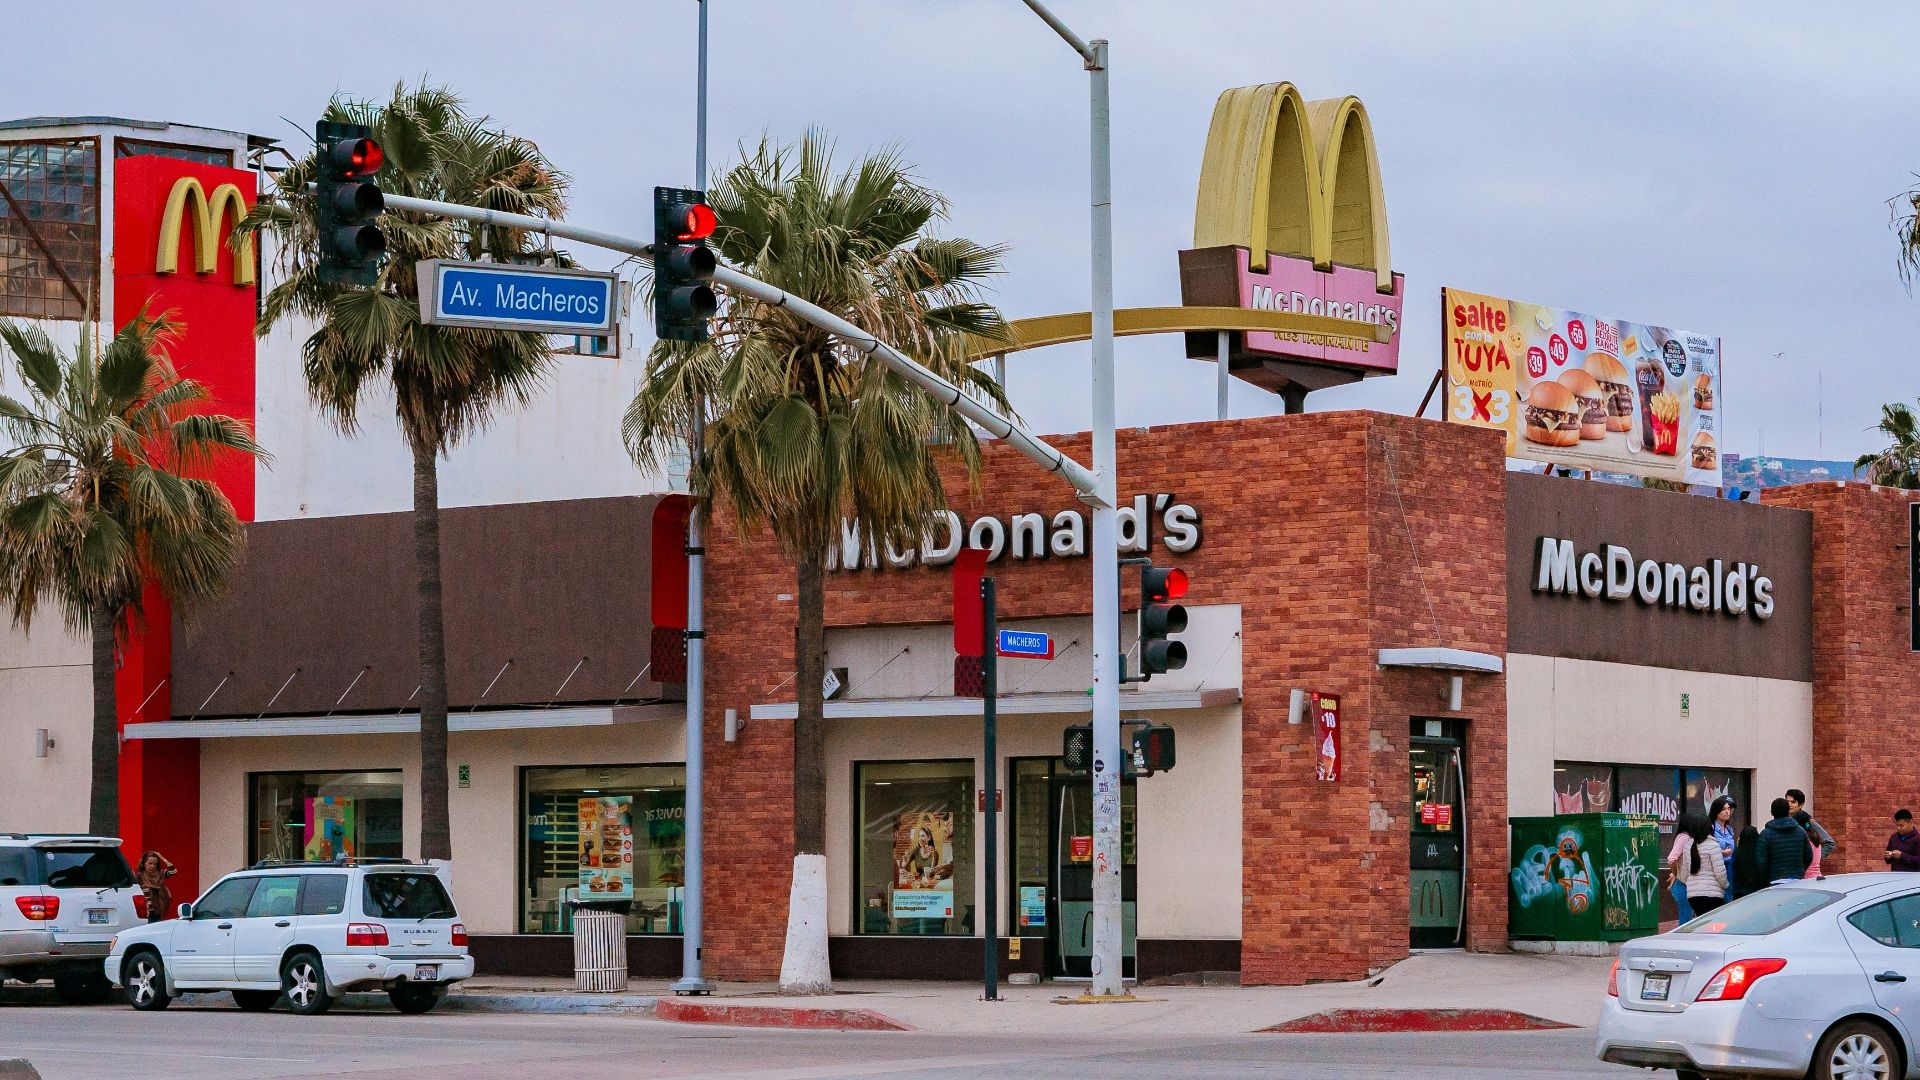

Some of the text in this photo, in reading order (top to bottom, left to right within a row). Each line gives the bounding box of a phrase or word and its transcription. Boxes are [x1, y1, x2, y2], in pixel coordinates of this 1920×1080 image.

[450, 280, 599, 315] Av. Macheros
[1453, 301, 1506, 334] salte
[1595, 319, 1610, 334] BBQ
[1454, 338, 1510, 372] TUYA
[1595, 337, 1619, 354] RANCH
[825, 493, 1198, 570] McDonad's
[1538, 537, 1774, 619] McDonald's
[1007, 635, 1041, 648] MACHEROS
[1320, 698, 1337, 711] CONO
[1621, 792, 1677, 821] MALTEADAS
